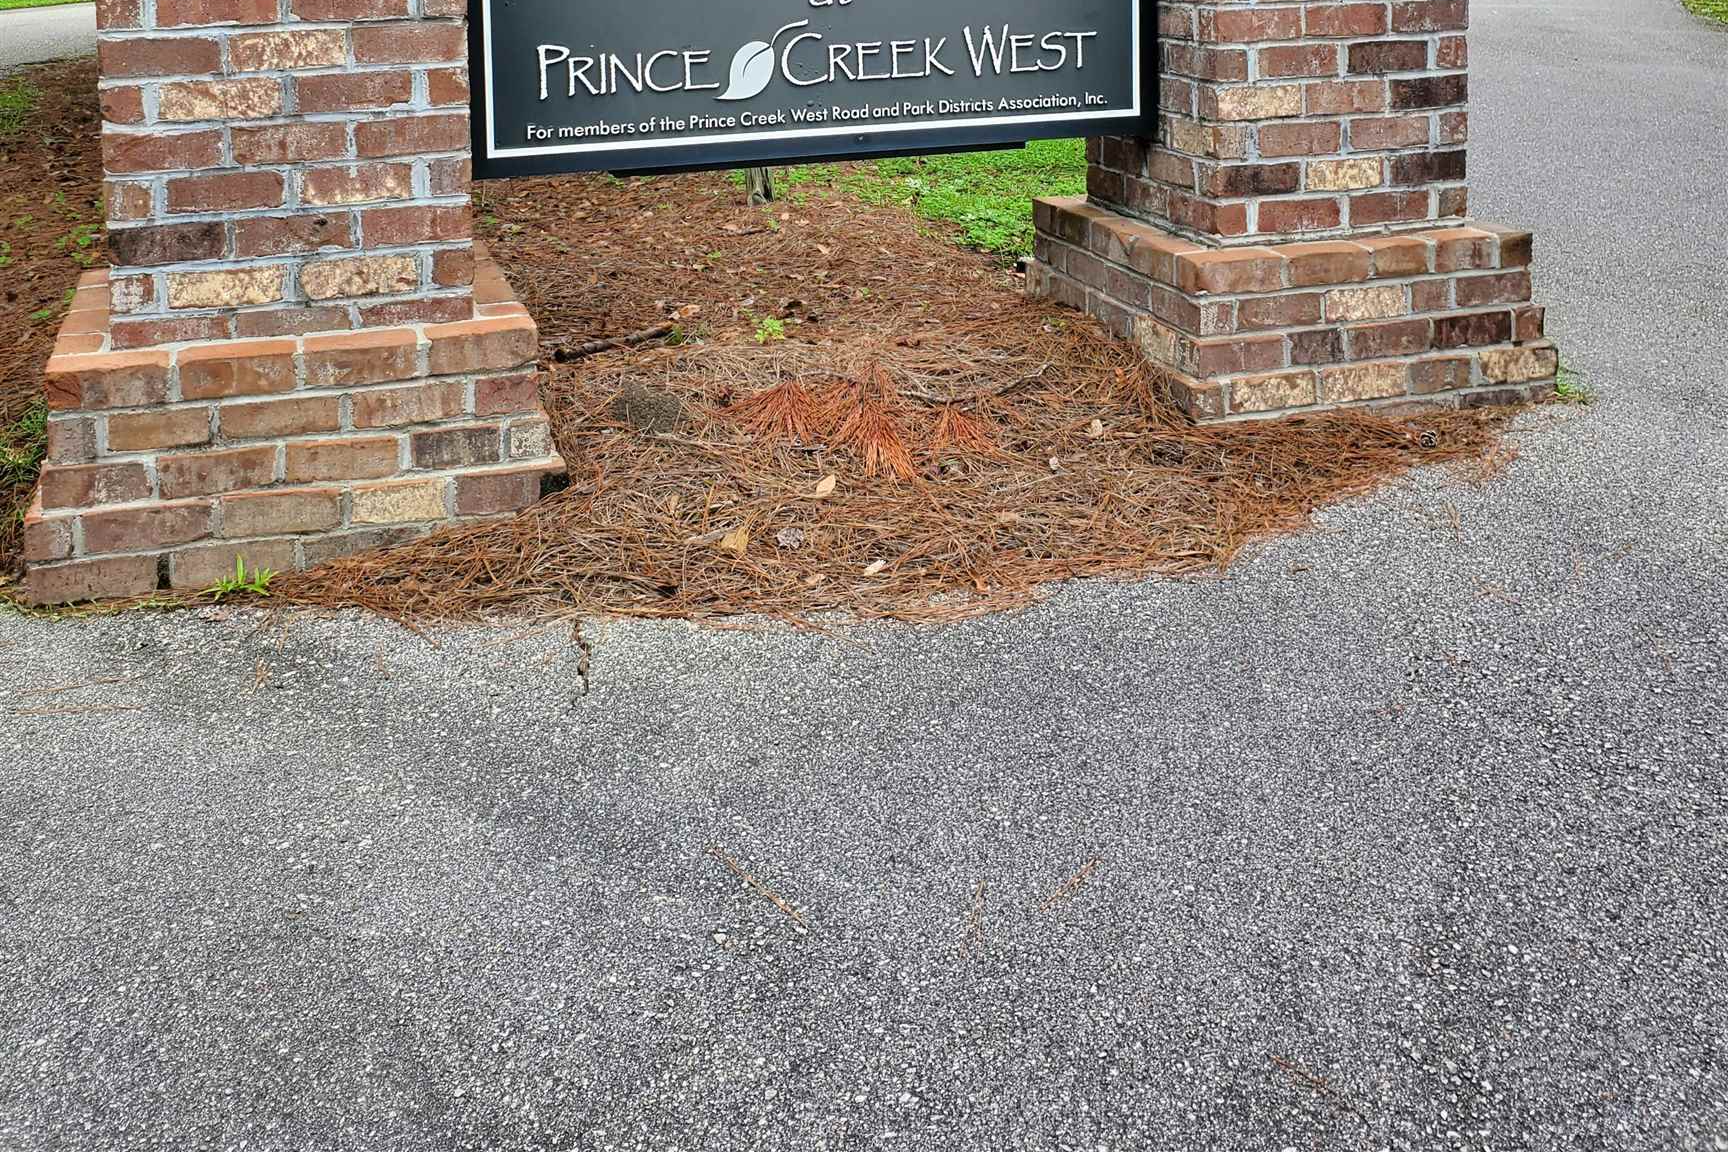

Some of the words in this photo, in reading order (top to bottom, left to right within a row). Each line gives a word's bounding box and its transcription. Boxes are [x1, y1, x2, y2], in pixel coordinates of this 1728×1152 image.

[536, 44, 719, 100] PRINCE
[780, 31, 956, 86] CREEK
[963, 23, 1098, 71] WEST
[527, 125, 555, 140] For
[558, 119, 636, 138] members
[638, 116, 657, 133] of
[659, 115, 686, 131] the
[689, 113, 736, 129] Prince
[740, 108, 786, 126] Creek
[790, 108, 829, 122] West
[831, 105, 869, 120] Road
[872, 101, 900, 118] and
[903, 99, 935, 116] Park
[938, 98, 994, 114] Districts
[997, 93, 1082, 110] Association,
[1085, 90, 1109, 105] Inc.
